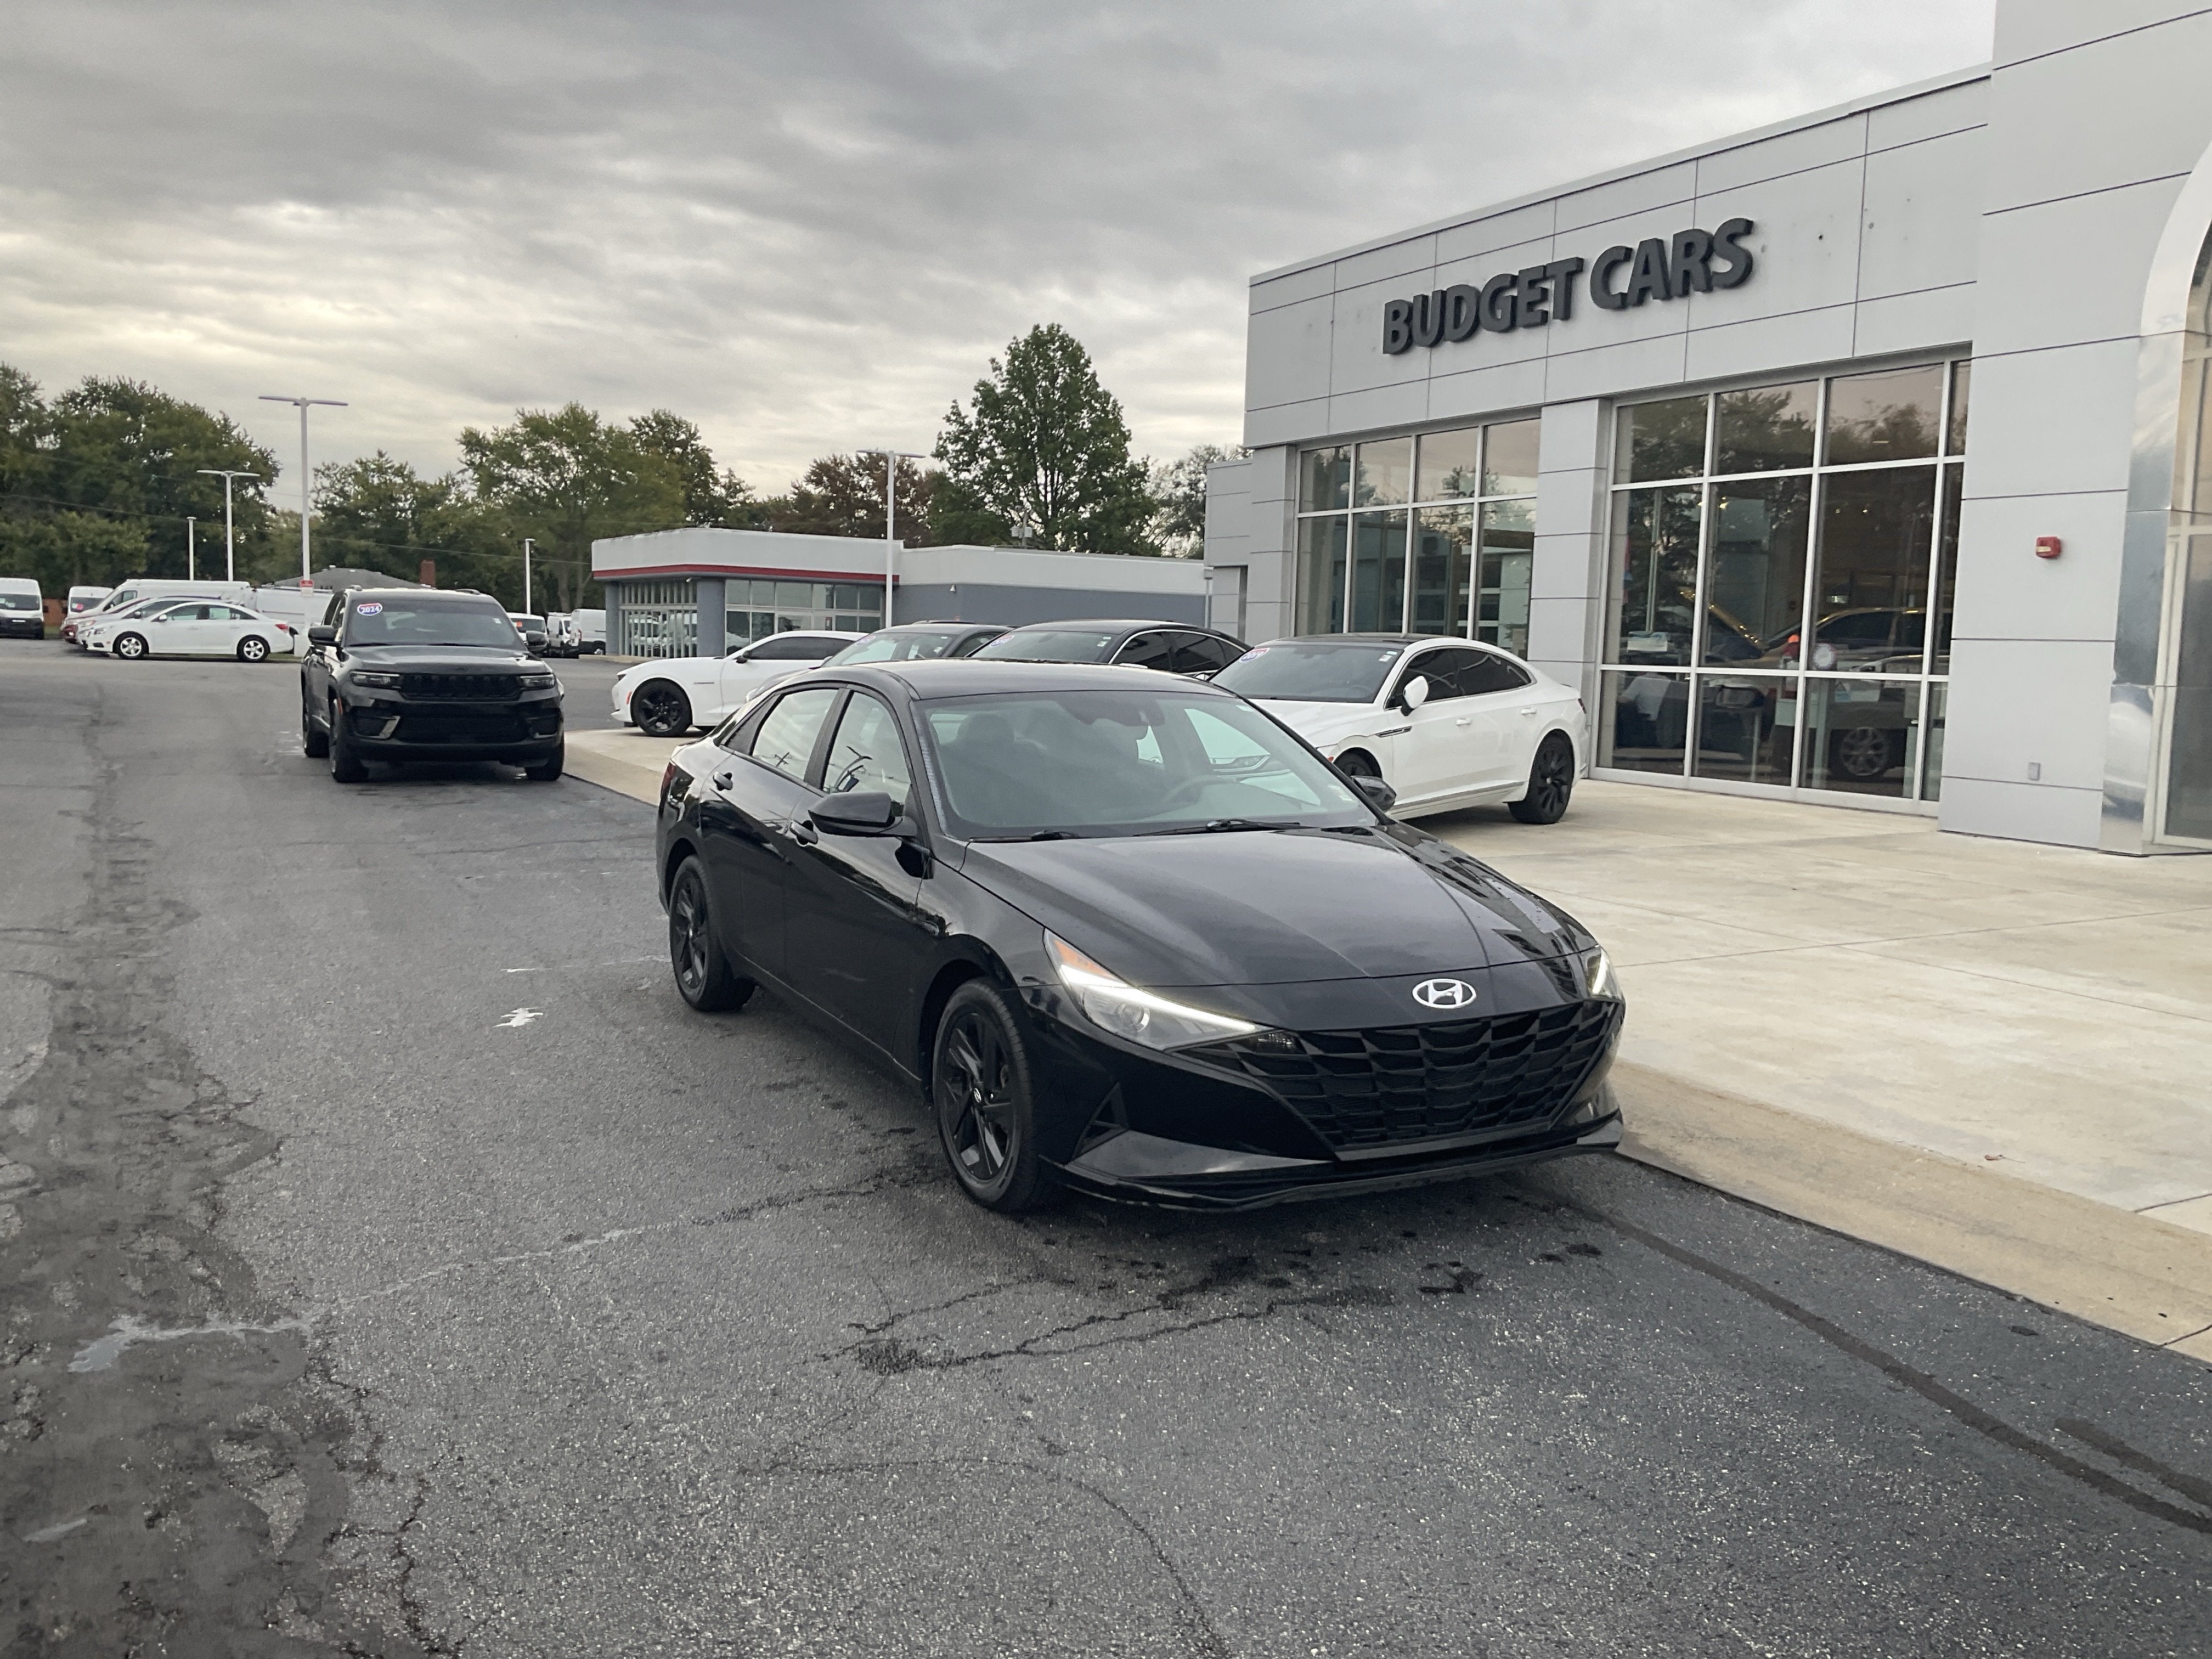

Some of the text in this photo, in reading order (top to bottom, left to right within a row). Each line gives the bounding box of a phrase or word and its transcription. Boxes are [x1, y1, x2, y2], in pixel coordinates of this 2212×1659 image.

[1383, 217, 1754, 355] BUDGET CARS
[360, 605, 380, 613] 2024
